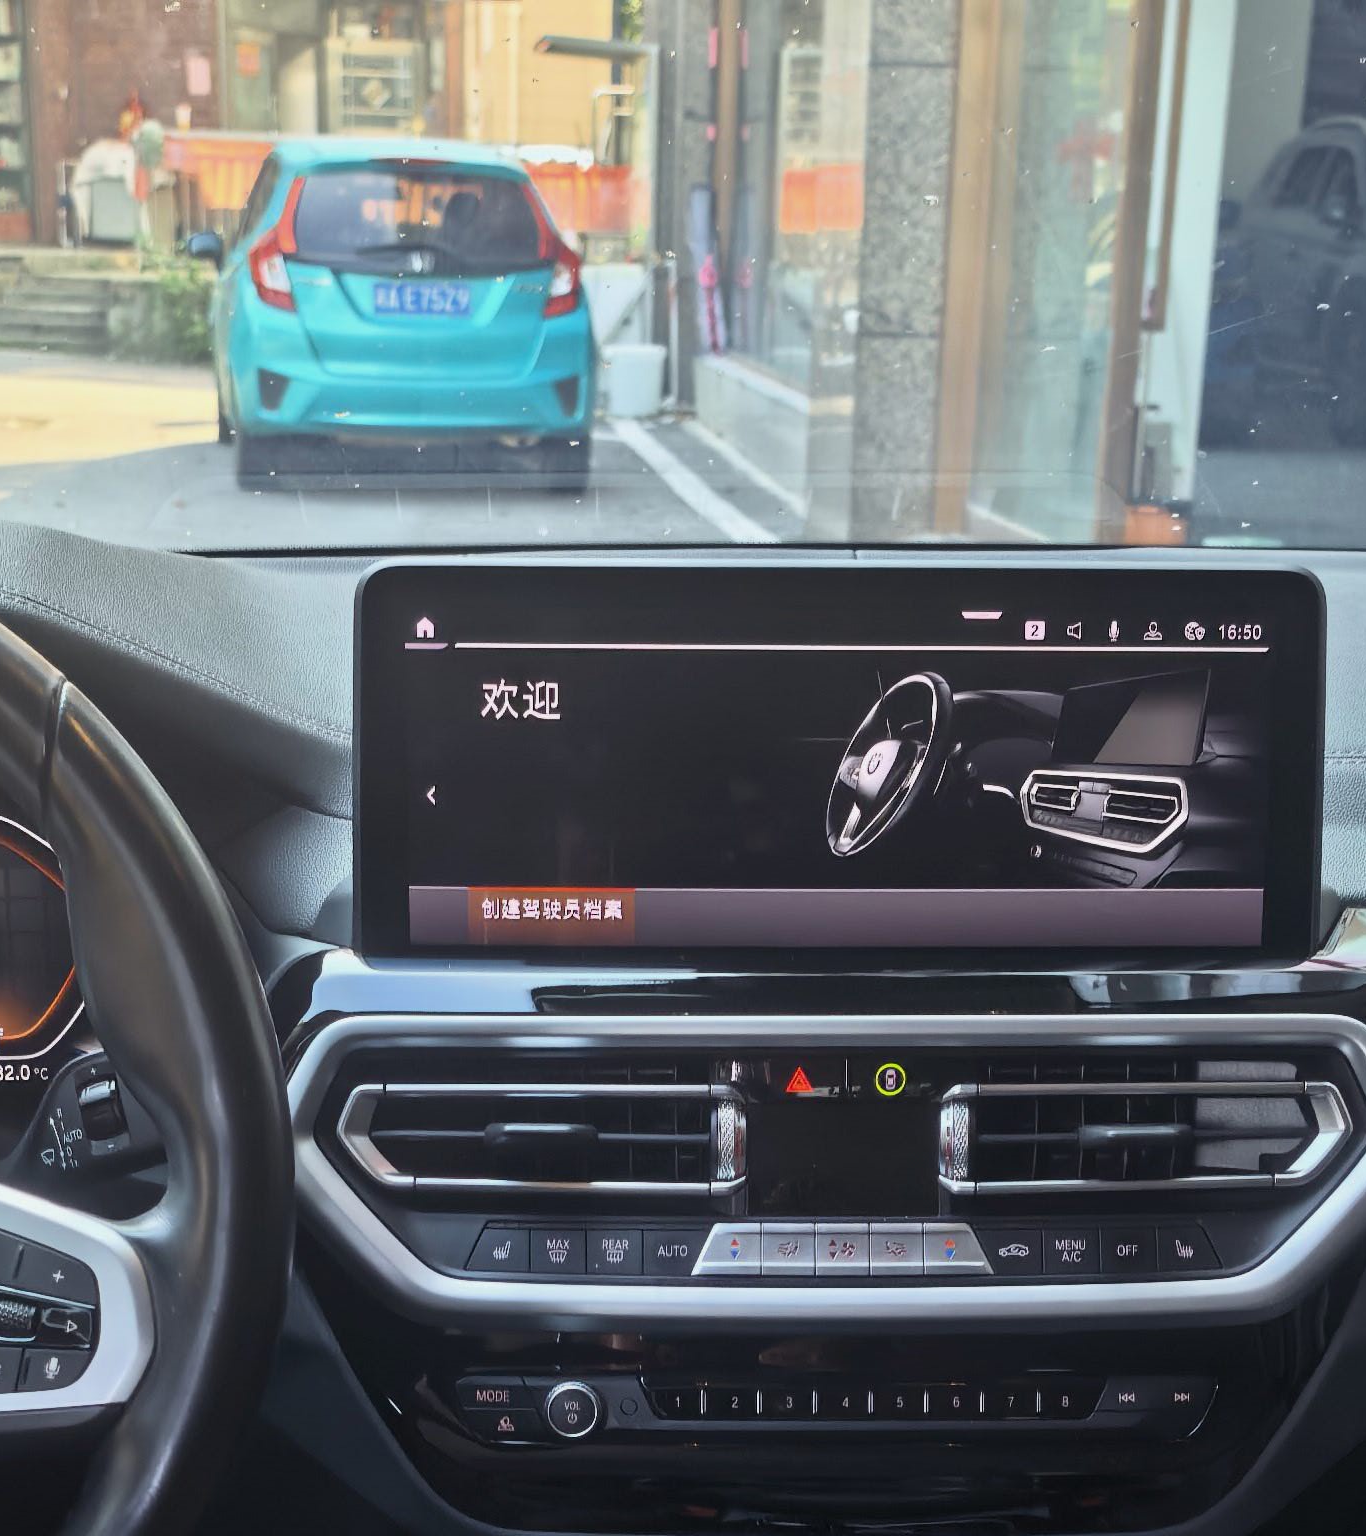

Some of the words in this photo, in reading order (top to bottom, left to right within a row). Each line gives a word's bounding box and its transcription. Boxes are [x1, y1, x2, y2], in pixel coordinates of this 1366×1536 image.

[1218, 624, 1262, 641] 16:50
[480, 679, 562, 721] 欢迎
[482, 898, 623, 920] 创建驾驶员档案
[34, 1067, 49, 1080] °C
[546, 1239, 570, 1251] MAX
[601, 1239, 629, 1251] REAR
[657, 1245, 688, 1257] AUTO
[1055, 1239, 1086, 1251] MENU
[1117, 1245, 1138, 1256] OFF
[1061, 1251, 1081, 1263] A/C
[476, 1389, 510, 1403] MODE
[564, 1401, 580, 1412] VOL
